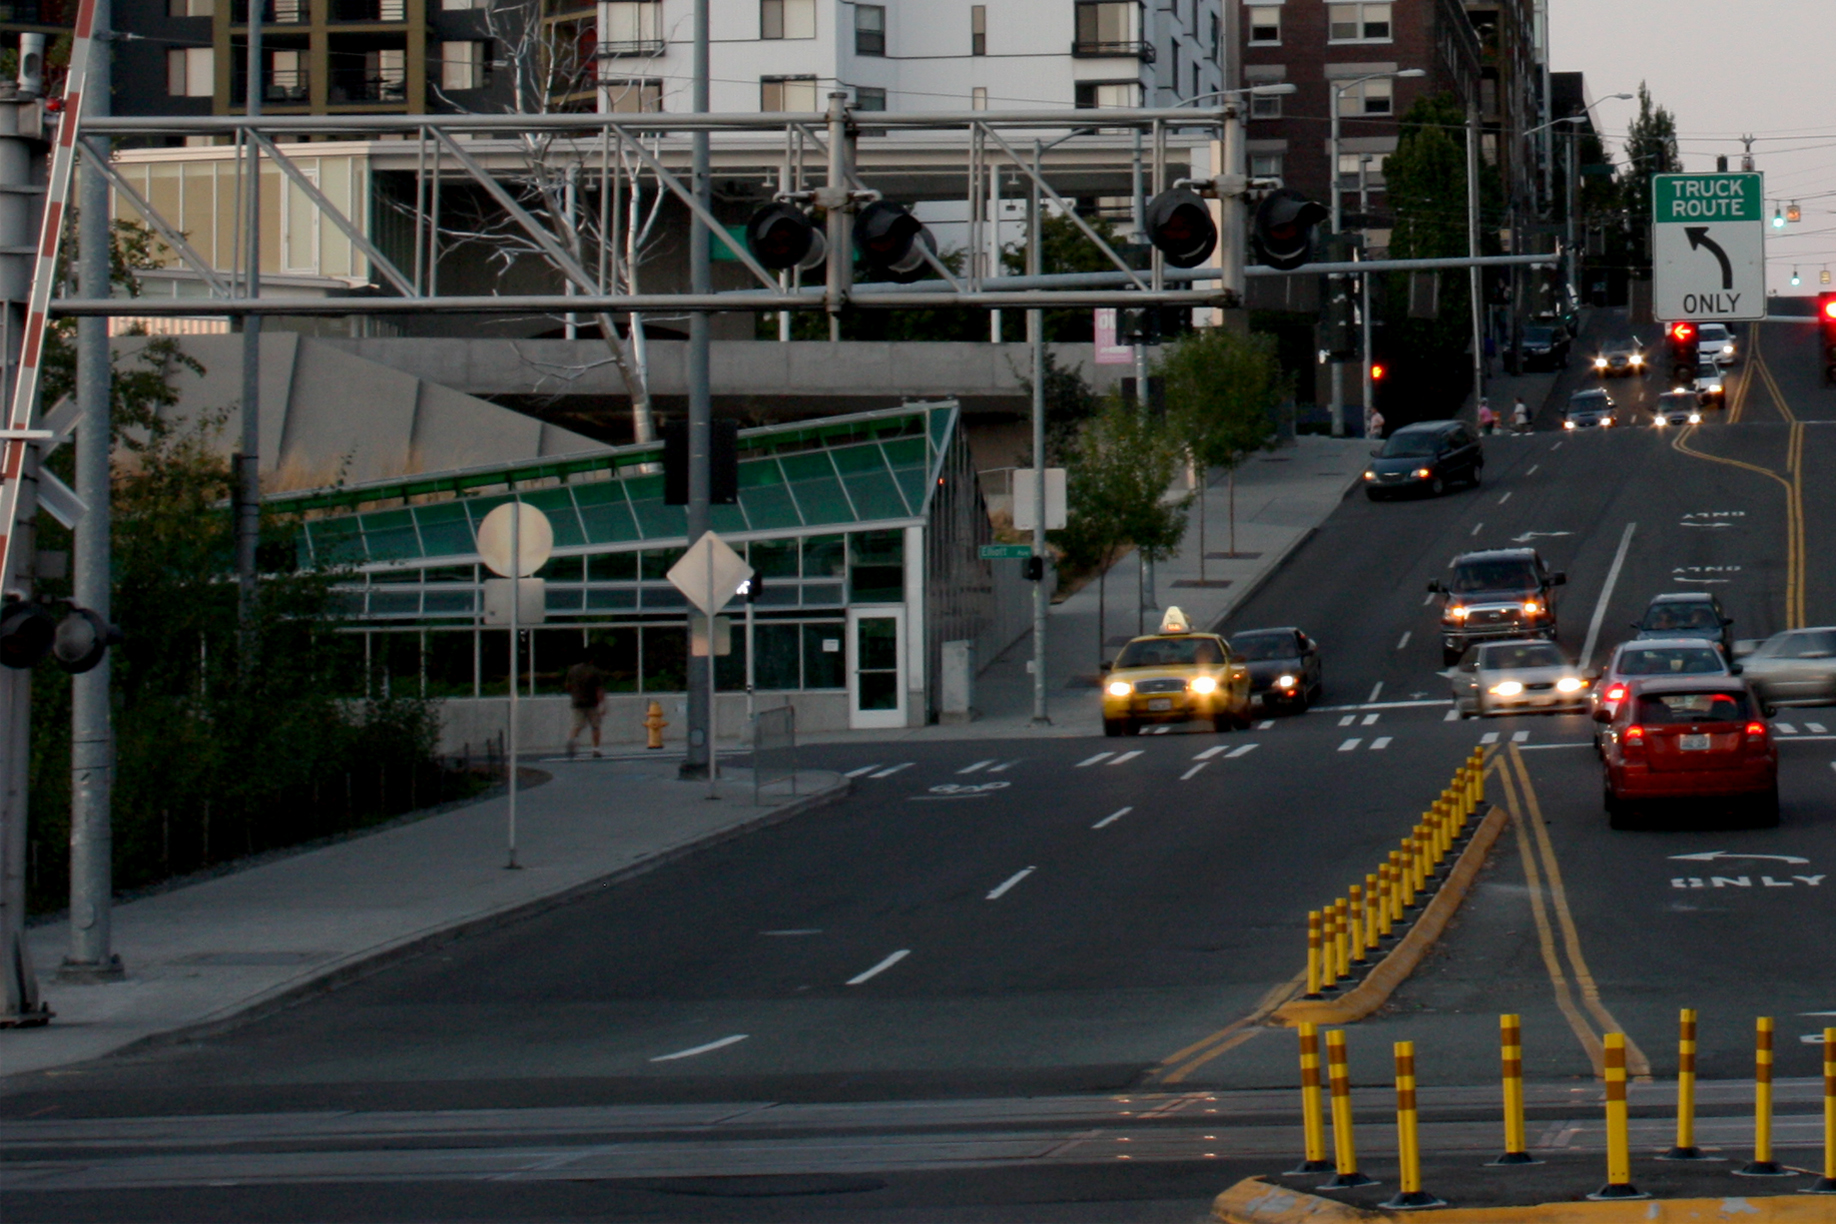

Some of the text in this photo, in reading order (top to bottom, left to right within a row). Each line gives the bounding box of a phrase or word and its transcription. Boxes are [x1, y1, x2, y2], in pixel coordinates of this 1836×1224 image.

[1671, 179, 1744, 197] TRUCK
[1672, 199, 1745, 217] ROUTE
[1683, 293, 1741, 314] ONLY
[1670, 875, 1826, 888] ONLY
